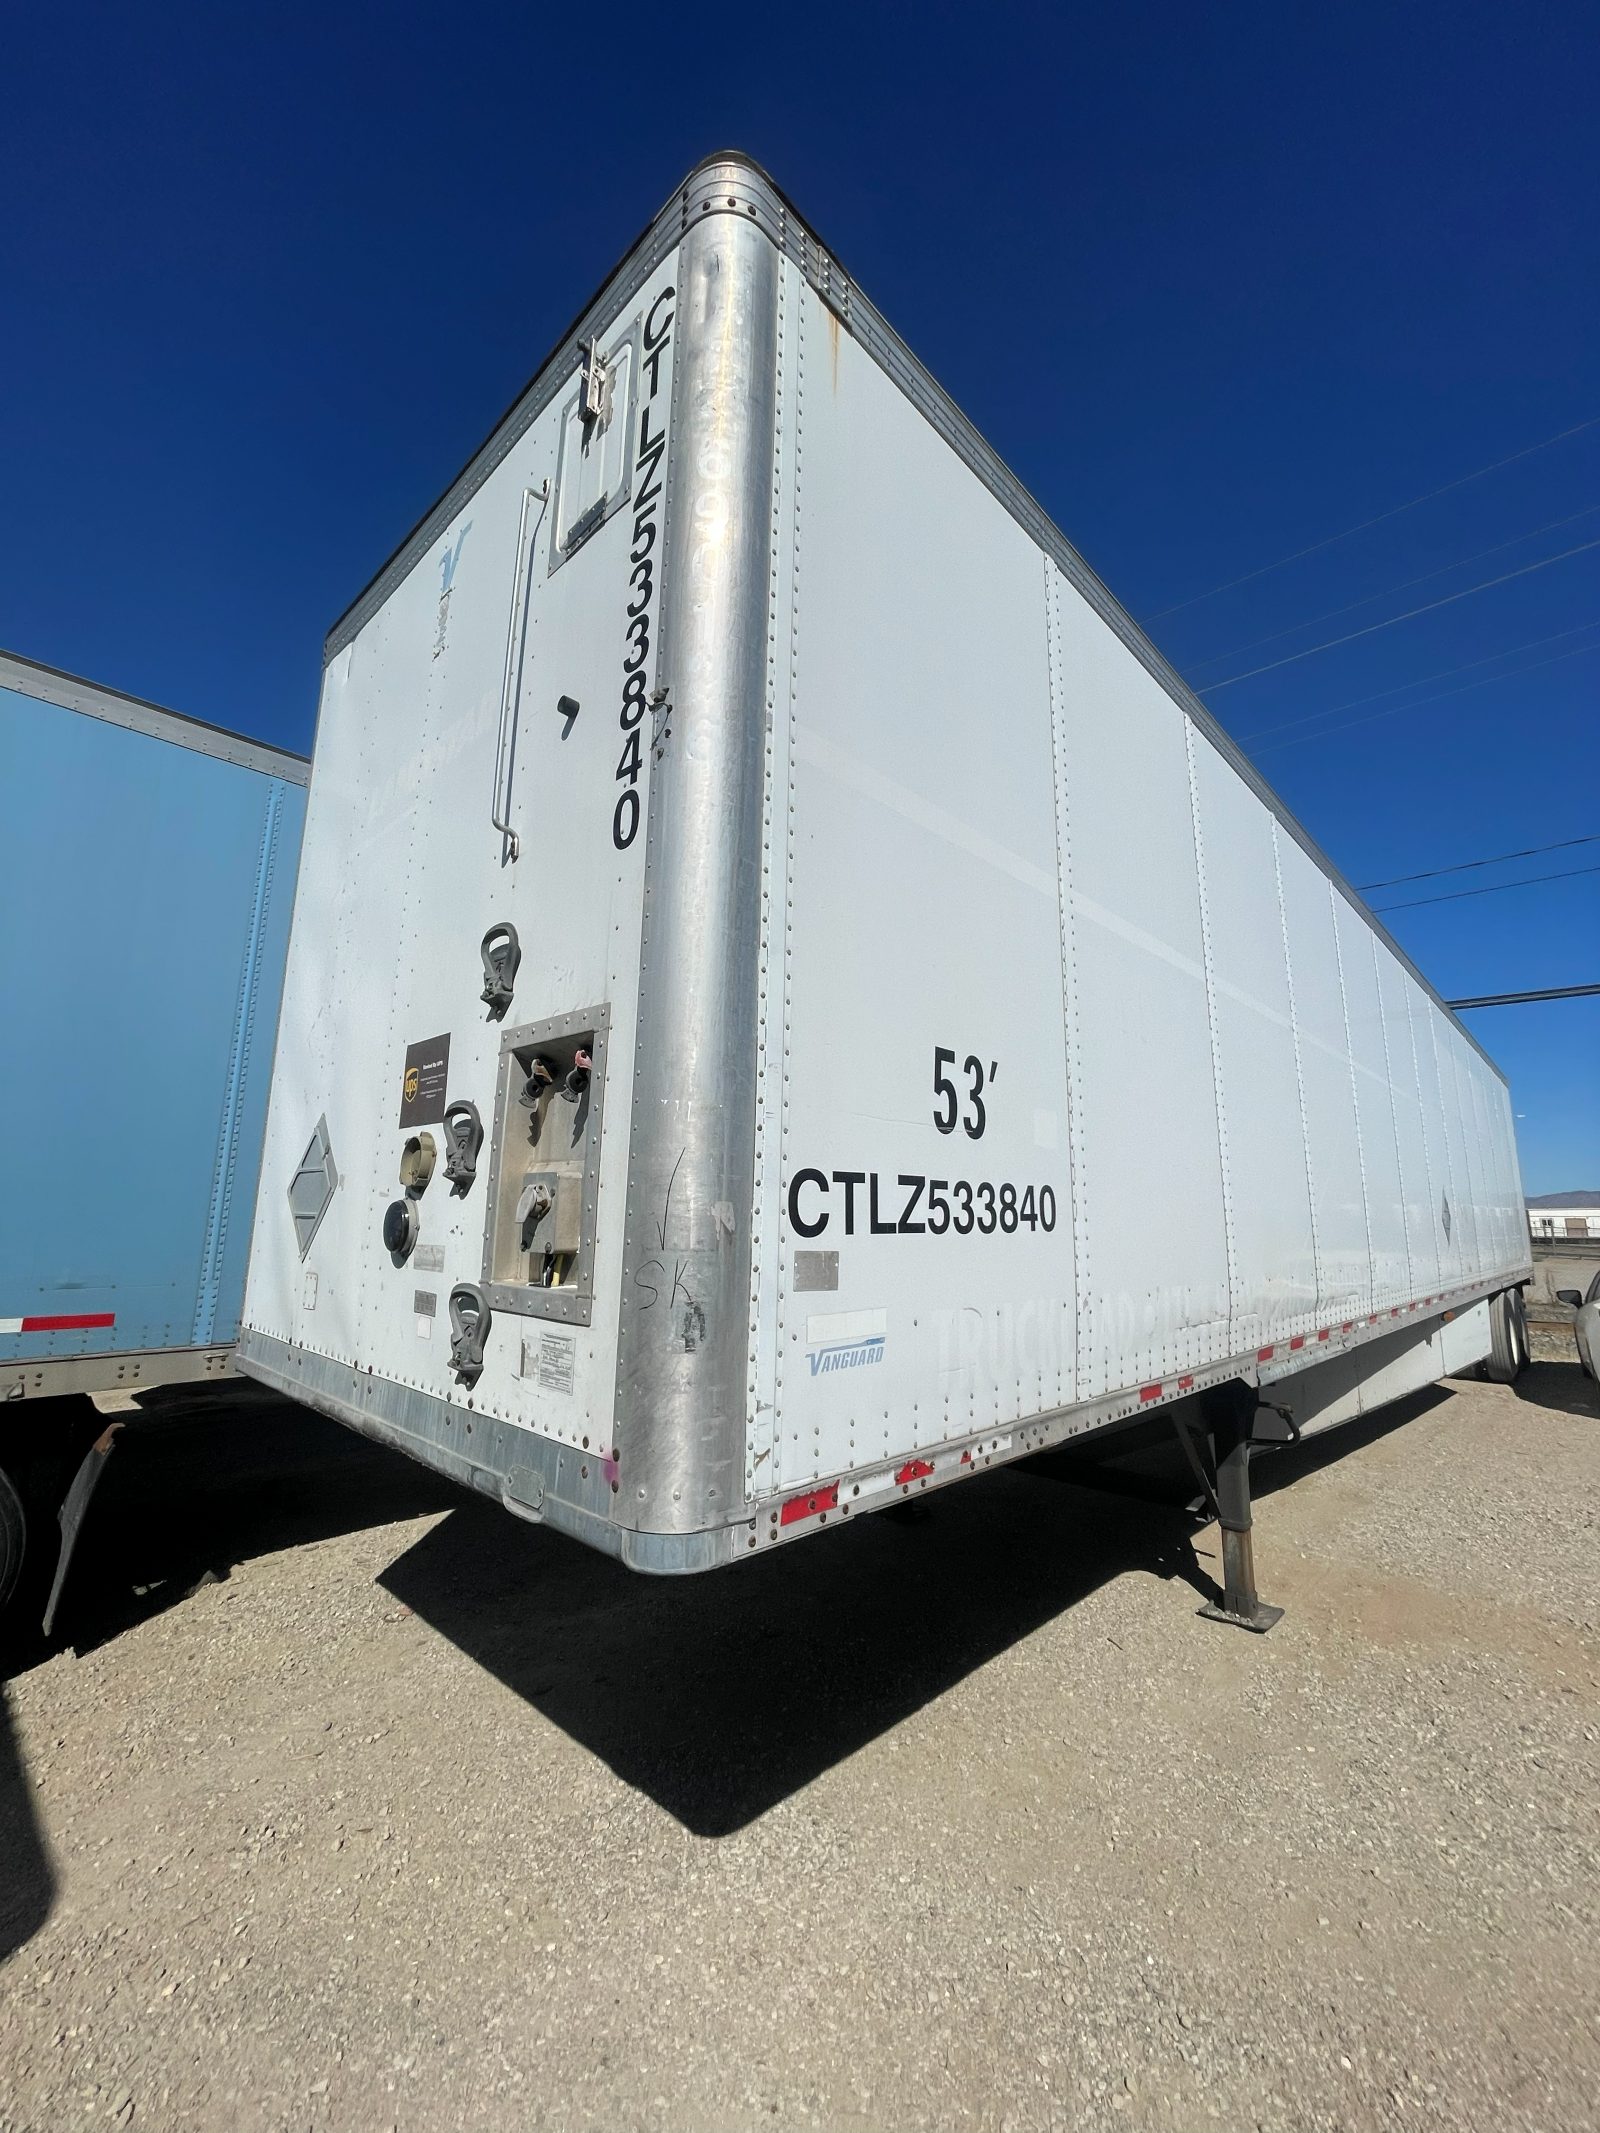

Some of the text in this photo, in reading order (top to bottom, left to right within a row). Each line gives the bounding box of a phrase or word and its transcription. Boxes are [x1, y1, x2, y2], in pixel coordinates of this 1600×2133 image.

[612, 285, 676, 850] CTLZ533840
[932, 1046, 999, 1140] 53'
[788, 1168, 1057, 1238] CTLZ533840
[633, 1259, 692, 1311] SK
[805, 1337, 886, 1377] VANGUARD
